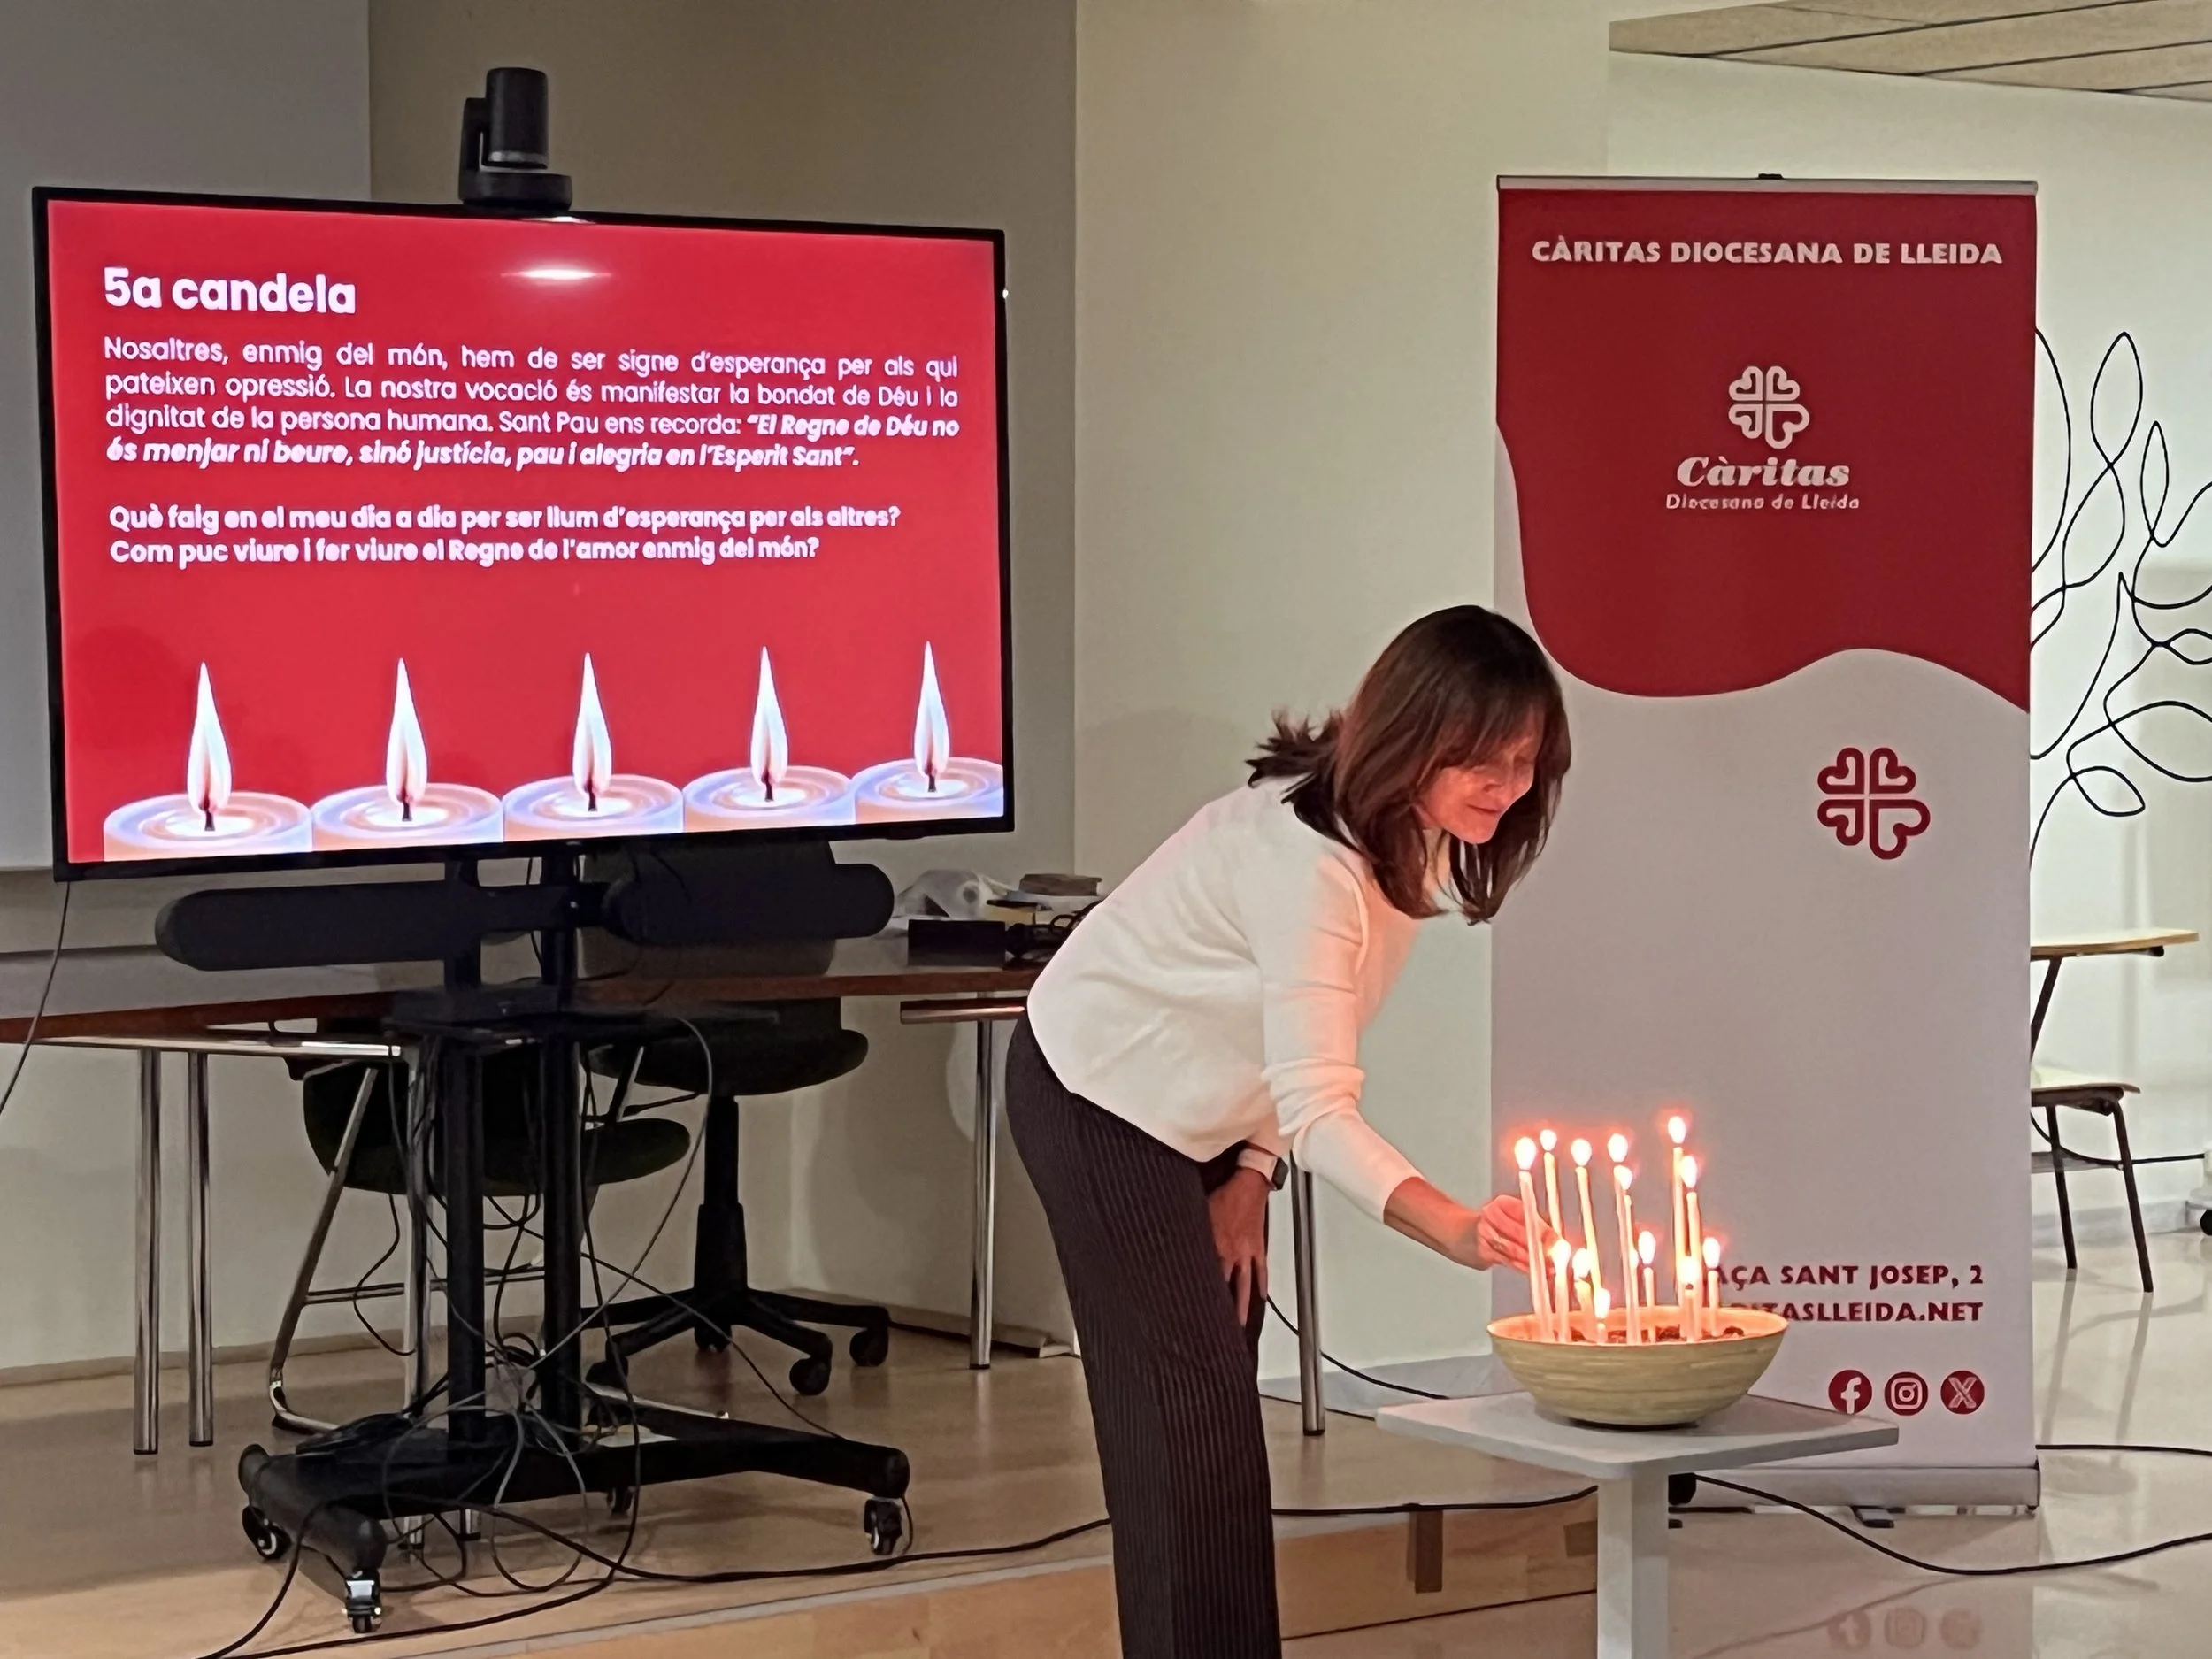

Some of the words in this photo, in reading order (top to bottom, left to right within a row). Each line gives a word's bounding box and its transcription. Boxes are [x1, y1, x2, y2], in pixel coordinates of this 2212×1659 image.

[1532, 236, 1661, 262] CÀRITAS
[1671, 243, 1843, 264] DIOCESANA
[1854, 244, 1890, 264] DE
[1901, 244, 2003, 264] LLEIDA
[104, 266, 162, 309] 5a
[172, 273, 356, 314] candela
[104, 336, 228, 365] Nosaltres,
[242, 340, 322, 371] enmig
[336, 342, 373, 365] del
[388, 342, 448, 370] món,
[461, 345, 515, 368] hem
[527, 346, 558, 370] de
[571, 352, 606, 370] ser
[618, 349, 679, 378] signe
[837, 357, 872, 380] per
[885, 356, 914, 376] als
[926, 356, 958, 382] qui
[105, 371, 215, 400] pateixen
[225, 373, 335, 403] opressió.
[345, 376, 372, 398] La
[381, 378, 457, 399] nostra
[465, 379, 558, 401] vocació
[566, 379, 592, 402] és
[601, 380, 721, 403] manifestar
[730, 383, 749, 404] la
[757, 383, 835, 405] bondat
[842, 385, 870, 406] de
[878, 386, 918, 407] Déu
[926, 386, 932, 407] i
[940, 388, 958, 407] la
[105, 403, 206, 434] dignitat
[211, 406, 245, 428] de
[251, 406, 274, 428] la
[280, 410, 380, 436] persona
[387, 408, 494, 432] humana.
[498, 411, 551, 433] Sant
[557, 411, 599, 434] Pau
[605, 416, 644, 434] ens
[650, 413, 741, 434] recorda:
[780, 416, 849, 442] Regne
[853, 415, 881, 436] de
[886, 415, 927, 436] Déu
[932, 420, 960, 436] no
[106, 436, 138, 461] és
[142, 437, 241, 469] menjar
[243, 438, 270, 462] ni
[358, 440, 411, 463] sinó
[413, 440, 512, 471] justícia,
[516, 446, 564, 472] pau
[568, 441, 577, 465] i
[580, 442, 664, 472] alegria
[665, 449, 695, 466] en
[1677, 456, 1850, 487] Càritas
[109, 503, 164, 533] Què
[167, 503, 219, 536] faig
[224, 510, 257, 528] en
[261, 505, 284, 528] el
[289, 510, 347, 528] meu
[351, 504, 391, 528] dia
[396, 511, 412, 528] a
[417, 504, 456, 528] dia
[461, 511, 502, 534] per
[505, 511, 542, 528] ser
[547, 505, 598, 528] llum
[749, 510, 787, 534] per
[790, 505, 824, 526] als
[826, 505, 901, 526] altres?
[1665, 493, 1765, 510] Diocesana
[1771, 494, 1794, 510] de
[1801, 494, 1860, 510] Lleida
[110, 540, 173, 562] Com
[179, 543, 228, 570] puc
[233, 537, 299, 562] viure
[303, 537, 311, 562] i
[316, 537, 350, 562] fer
[355, 537, 419, 561] viure
[422, 538, 445, 561] el
[449, 538, 525, 567] Regne
[528, 538, 558, 561] de
[642, 535, 715, 565] enmig
[719, 537, 754, 558] del
[758, 534, 819, 558] món?
[1780, 1264, 1858, 1285] SANT
[1869, 1265, 1959, 1290] JOSEP,
[1970, 1265, 1983, 1285] 2
